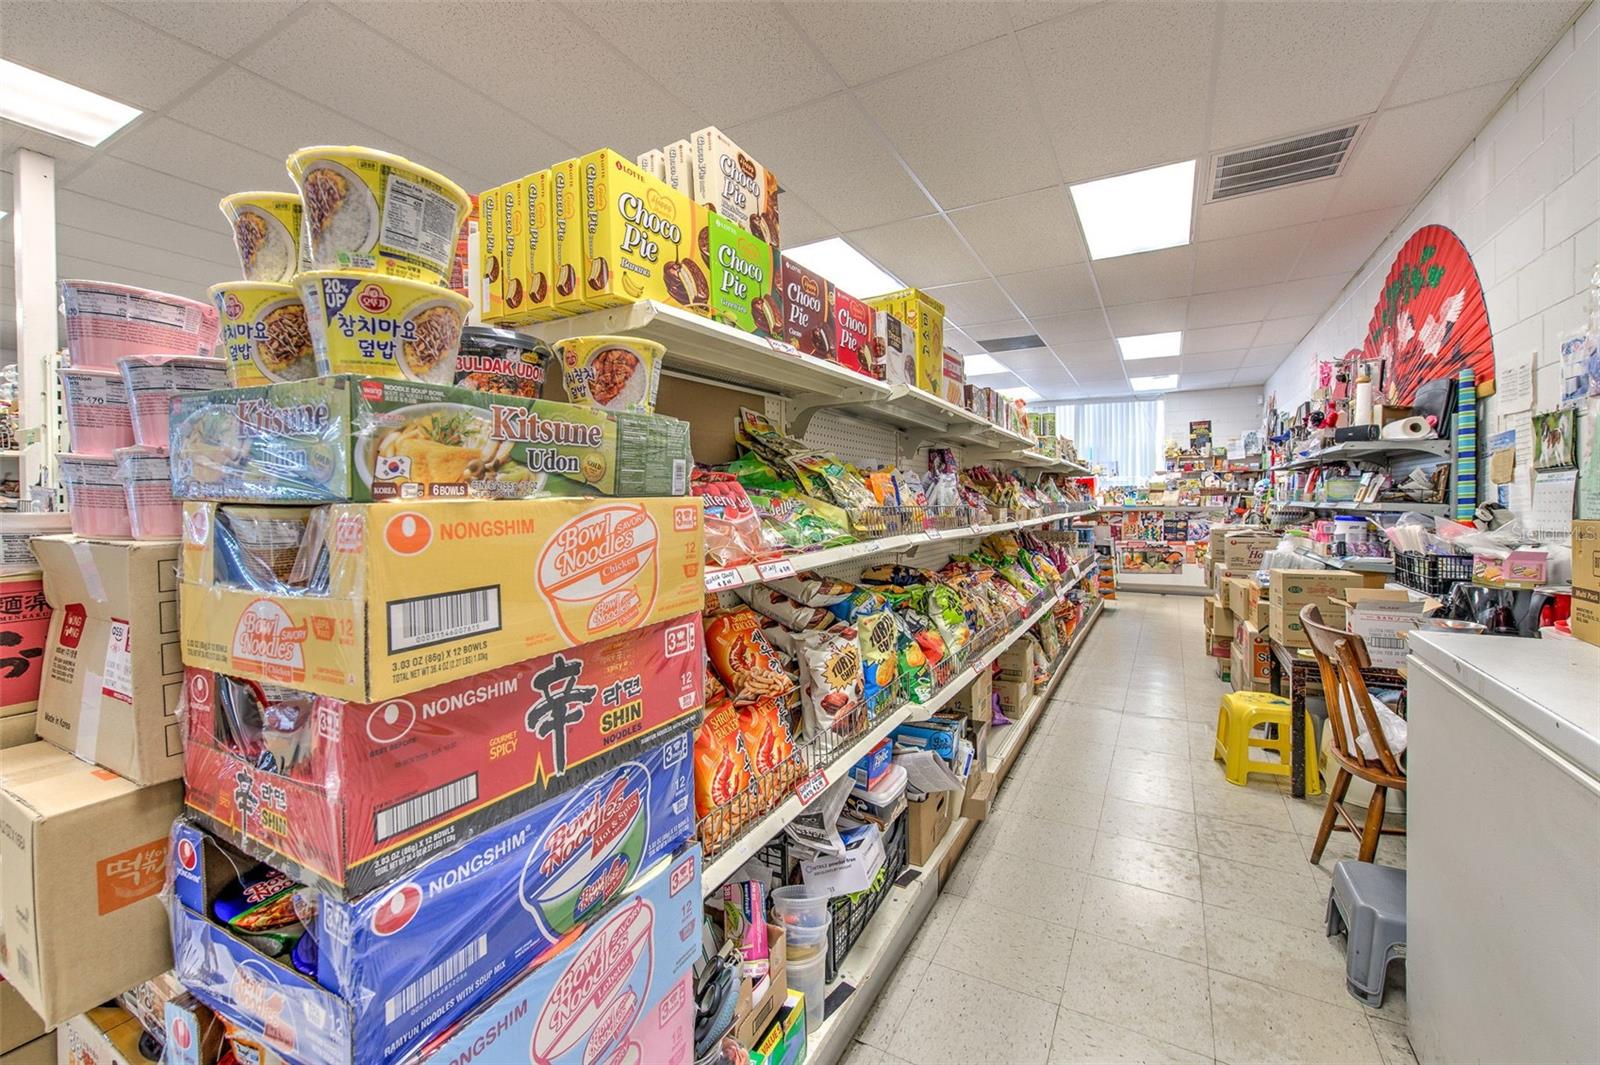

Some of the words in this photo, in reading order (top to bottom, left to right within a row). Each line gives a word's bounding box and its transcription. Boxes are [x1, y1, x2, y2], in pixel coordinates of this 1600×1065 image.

[586, 163, 596, 209] Choco
[623, 165, 645, 183] LOTTE
[720, 154, 760, 197] Choco
[528, 183, 537, 226] Choco
[555, 172, 564, 216] Choco
[722, 177, 746, 208] Pie
[486, 196, 494, 233] Choco
[505, 192, 514, 233] Choco
[587, 210, 598, 234] Pie
[618, 192, 681, 244] Choco
[529, 227, 538, 250] Pie
[556, 217, 566, 241] Pie
[620, 221, 658, 262] Pie
[487, 234, 495, 254] Pie
[506, 234, 514, 257] Pie
[718, 244, 763, 283] Choco
[323, 279, 349, 294] 20%
[720, 269, 747, 299] Pie
[787, 282, 820, 312] Choco
[327, 293, 345, 309] UP
[338, 313, 418, 342] 참치마요
[789, 304, 809, 327] Pie
[838, 308, 867, 336] Choco
[358, 340, 397, 361] 덮밥
[840, 329, 858, 351] Pie
[455, 354, 514, 377] BULDAK
[384, 384, 409, 393] NOODLE
[411, 387, 428, 395] SOUP
[490, 404, 603, 447] Kitsune
[526, 447, 580, 474] Udon
[439, 485, 465, 496] BOWLS
[440, 519, 535, 541] NONGSHIM
[557, 513, 611, 551] Bowl
[616, 512, 646, 533] SAVORY
[676, 511, 683, 526] 3
[555, 530, 634, 577] Noodles
[685, 541, 696, 553] 12
[602, 555, 636, 577] Chicken
[243, 610, 279, 636] Bowl
[240, 632, 295, 661] Noodles
[668, 632, 677, 651] 3
[392, 660, 410, 672] 3.03
[412, 656, 424, 667] OZ
[446, 650, 451, 658] X
[453, 647, 461, 656] 12
[463, 641, 488, 653] BOWLS
[392, 673, 409, 684] TOTAL
[602, 674, 642, 707] 라면
[681, 671, 692, 686] 12
[422, 678, 518, 719] NONGSHIM
[525, 653, 598, 776] 辛
[602, 701, 642, 733] SHIN
[489, 731, 518, 747] GOURMET
[603, 723, 643, 746] NOODLES
[489, 739, 518, 760] SPICY
[665, 746, 673, 762] 3
[675, 775, 686, 790] 12
[433, 825, 455, 840] BOWLS
[539, 792, 624, 877] Noodles
[544, 790, 601, 852] Bowl
[595, 827, 610, 848] Hot
[617, 799, 637, 822] Spicy
[428, 830, 527, 897] NONGSHIM
[671, 872, 679, 891] 3
[682, 900, 693, 917] 12
[552, 932, 607, 1004] Bowl
[611, 904, 642, 943] SAVORY
[550, 933, 629, 1032] Noodles
[597, 956, 631, 997] Lobster
[384, 1023, 419, 1057] RAMYUN
[421, 997, 455, 1030] NOODLES
[455, 984, 474, 1003] WITH
[475, 970, 493, 989] SOUP
[494, 959, 506, 974] MIX
